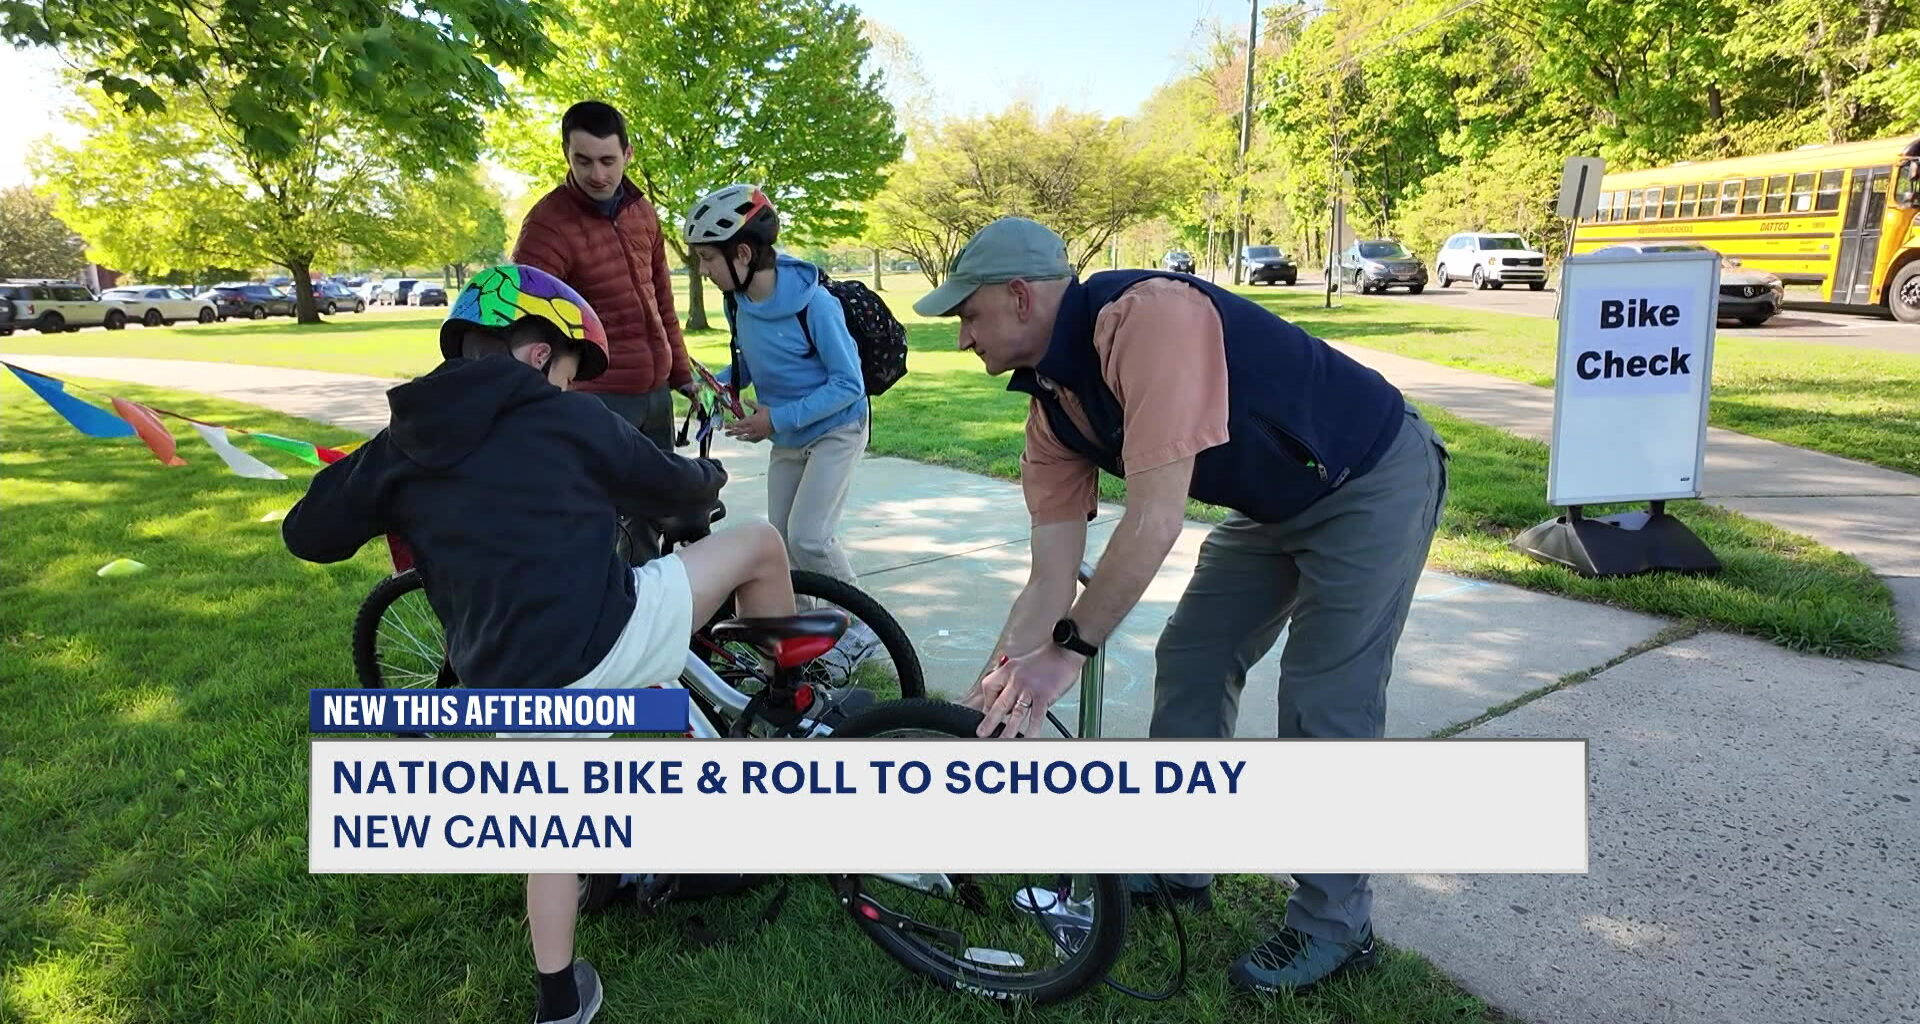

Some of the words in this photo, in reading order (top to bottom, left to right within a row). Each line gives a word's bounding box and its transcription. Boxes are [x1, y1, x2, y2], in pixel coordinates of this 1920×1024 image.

[1760, 222, 1789, 232] DATTCO
[1600, 299, 1680, 329] Bike
[1576, 347, 1691, 380] Check
